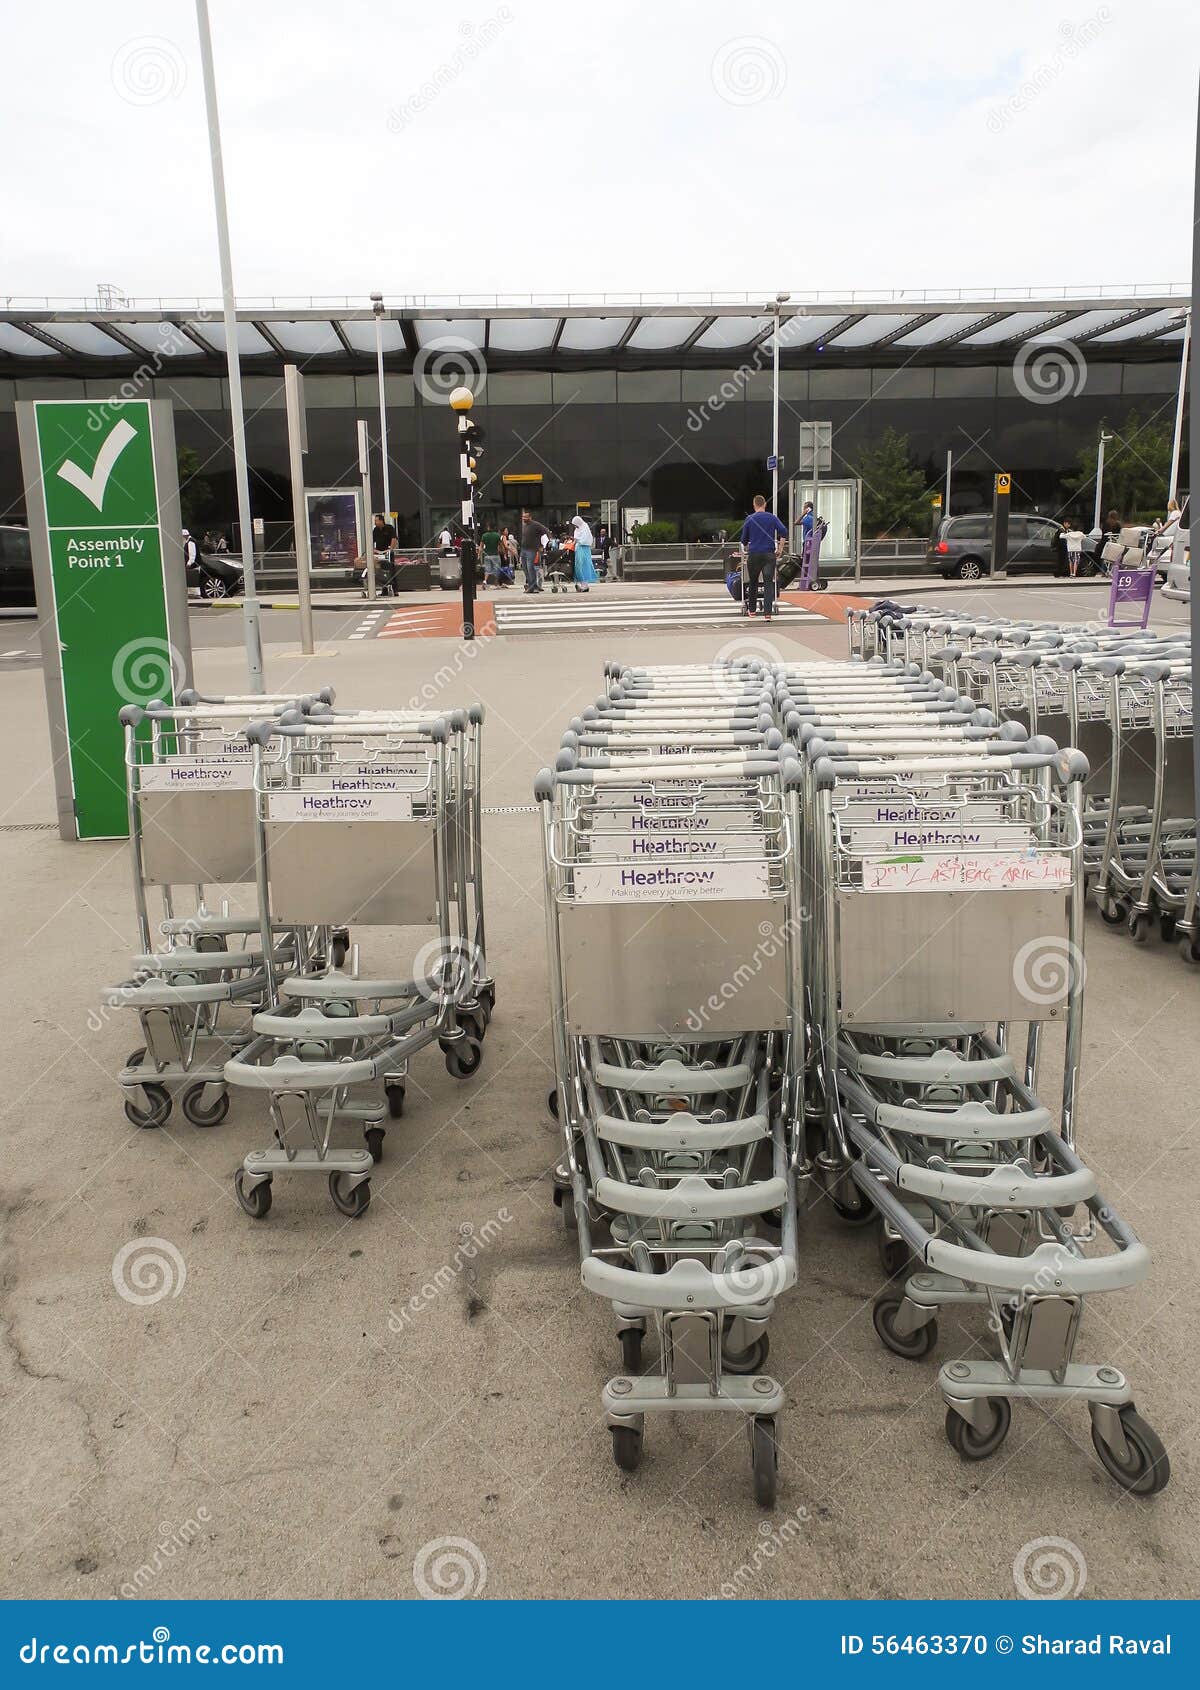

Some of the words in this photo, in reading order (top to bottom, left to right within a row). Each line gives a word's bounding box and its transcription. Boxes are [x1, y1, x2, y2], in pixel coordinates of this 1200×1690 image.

[67, 536, 144, 553] Assembly
[68, 555, 111, 568] Point
[115, 554, 124, 568] 1
[1118, 576, 1132, 587] £9
[171, 768, 232, 779] Heathrow
[332, 779, 396, 790] Heathrow
[303, 796, 372, 809] Heathrow
[877, 808, 956, 821] Heathrow
[894, 830, 980, 845] Heathrow
[632, 838, 717, 853] Heathrow
[621, 868, 715, 886] Heathrow
[611, 889, 641, 898] Making
[643, 889, 665, 898] every
[666, 887, 698, 897] journey
[700, 886, 725, 895] better
